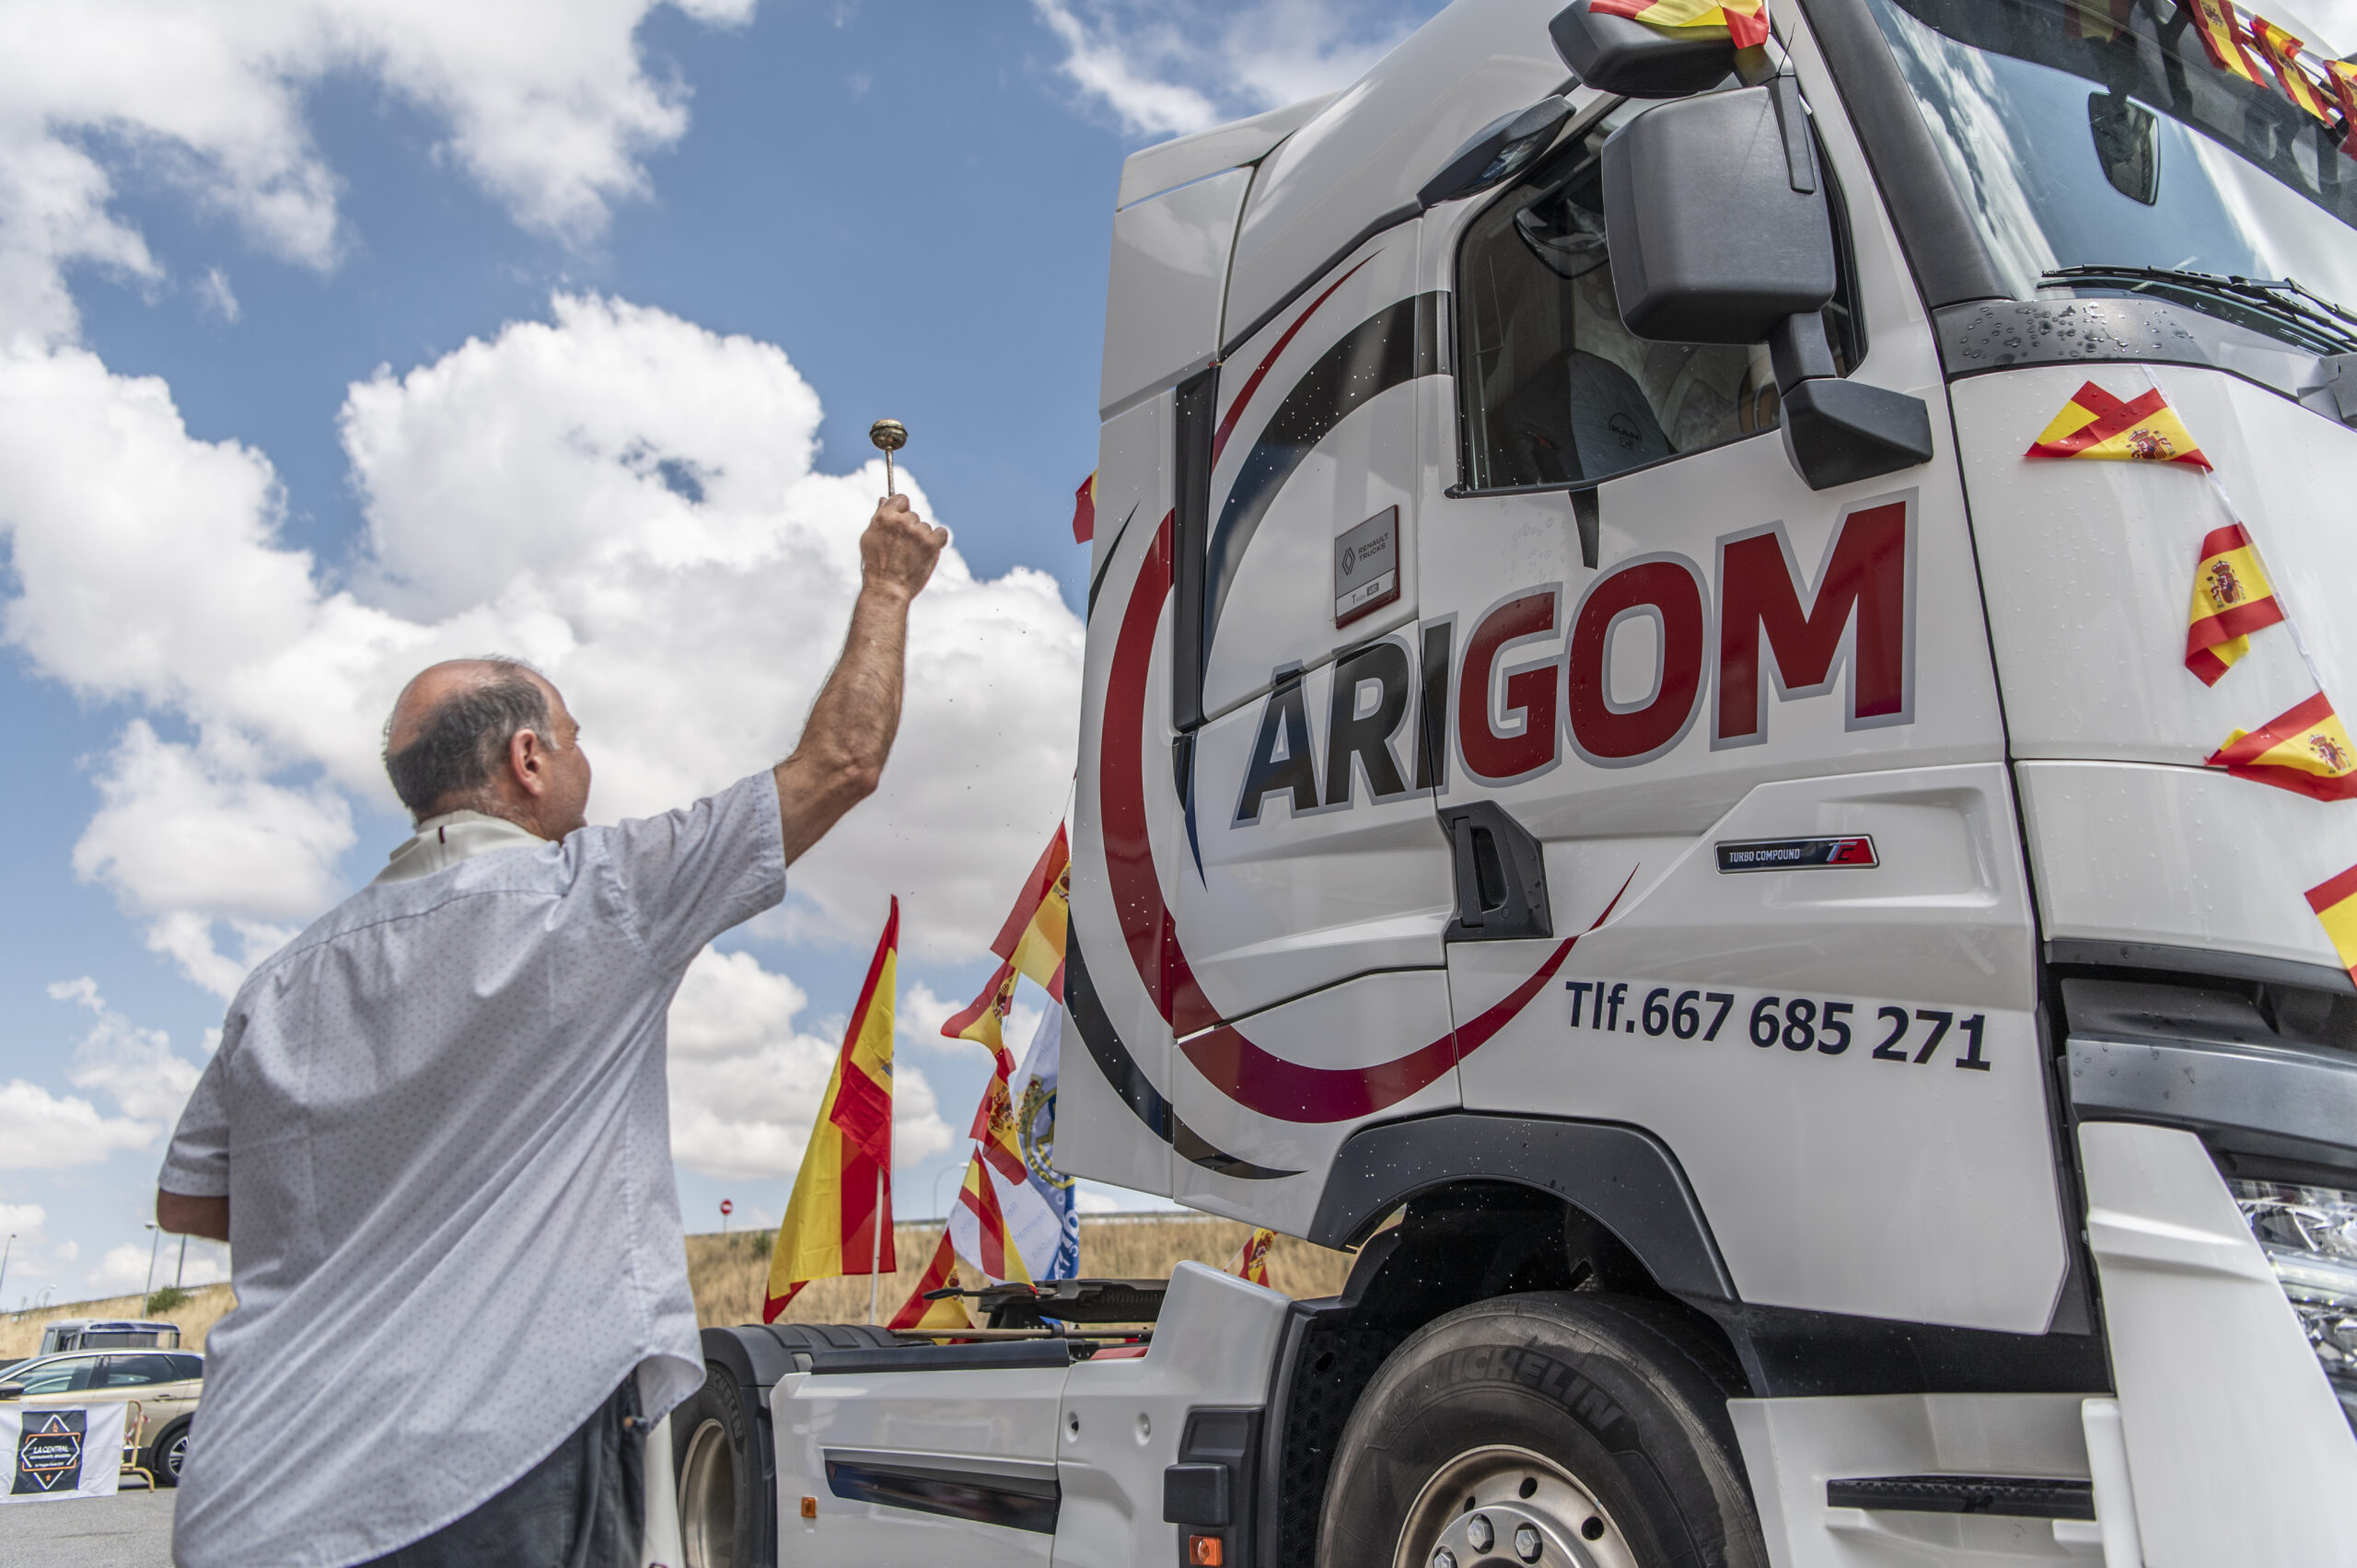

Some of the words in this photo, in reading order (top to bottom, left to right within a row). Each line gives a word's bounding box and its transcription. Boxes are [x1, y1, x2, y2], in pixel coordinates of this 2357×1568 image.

[1358, 532, 1389, 554] RENAULT
[1359, 542, 1386, 562] TRUCKS
[1231, 487, 1919, 829] ARIGOM
[1729, 851, 1755, 863] TURBO
[1756, 848, 1800, 863] COMPOUND
[1565, 981, 1735, 1042] Tlf.667
[1748, 996, 1854, 1055] 685
[1872, 1006, 1991, 1072] 271
[1418, 1347, 1625, 1432] MICHELIN
